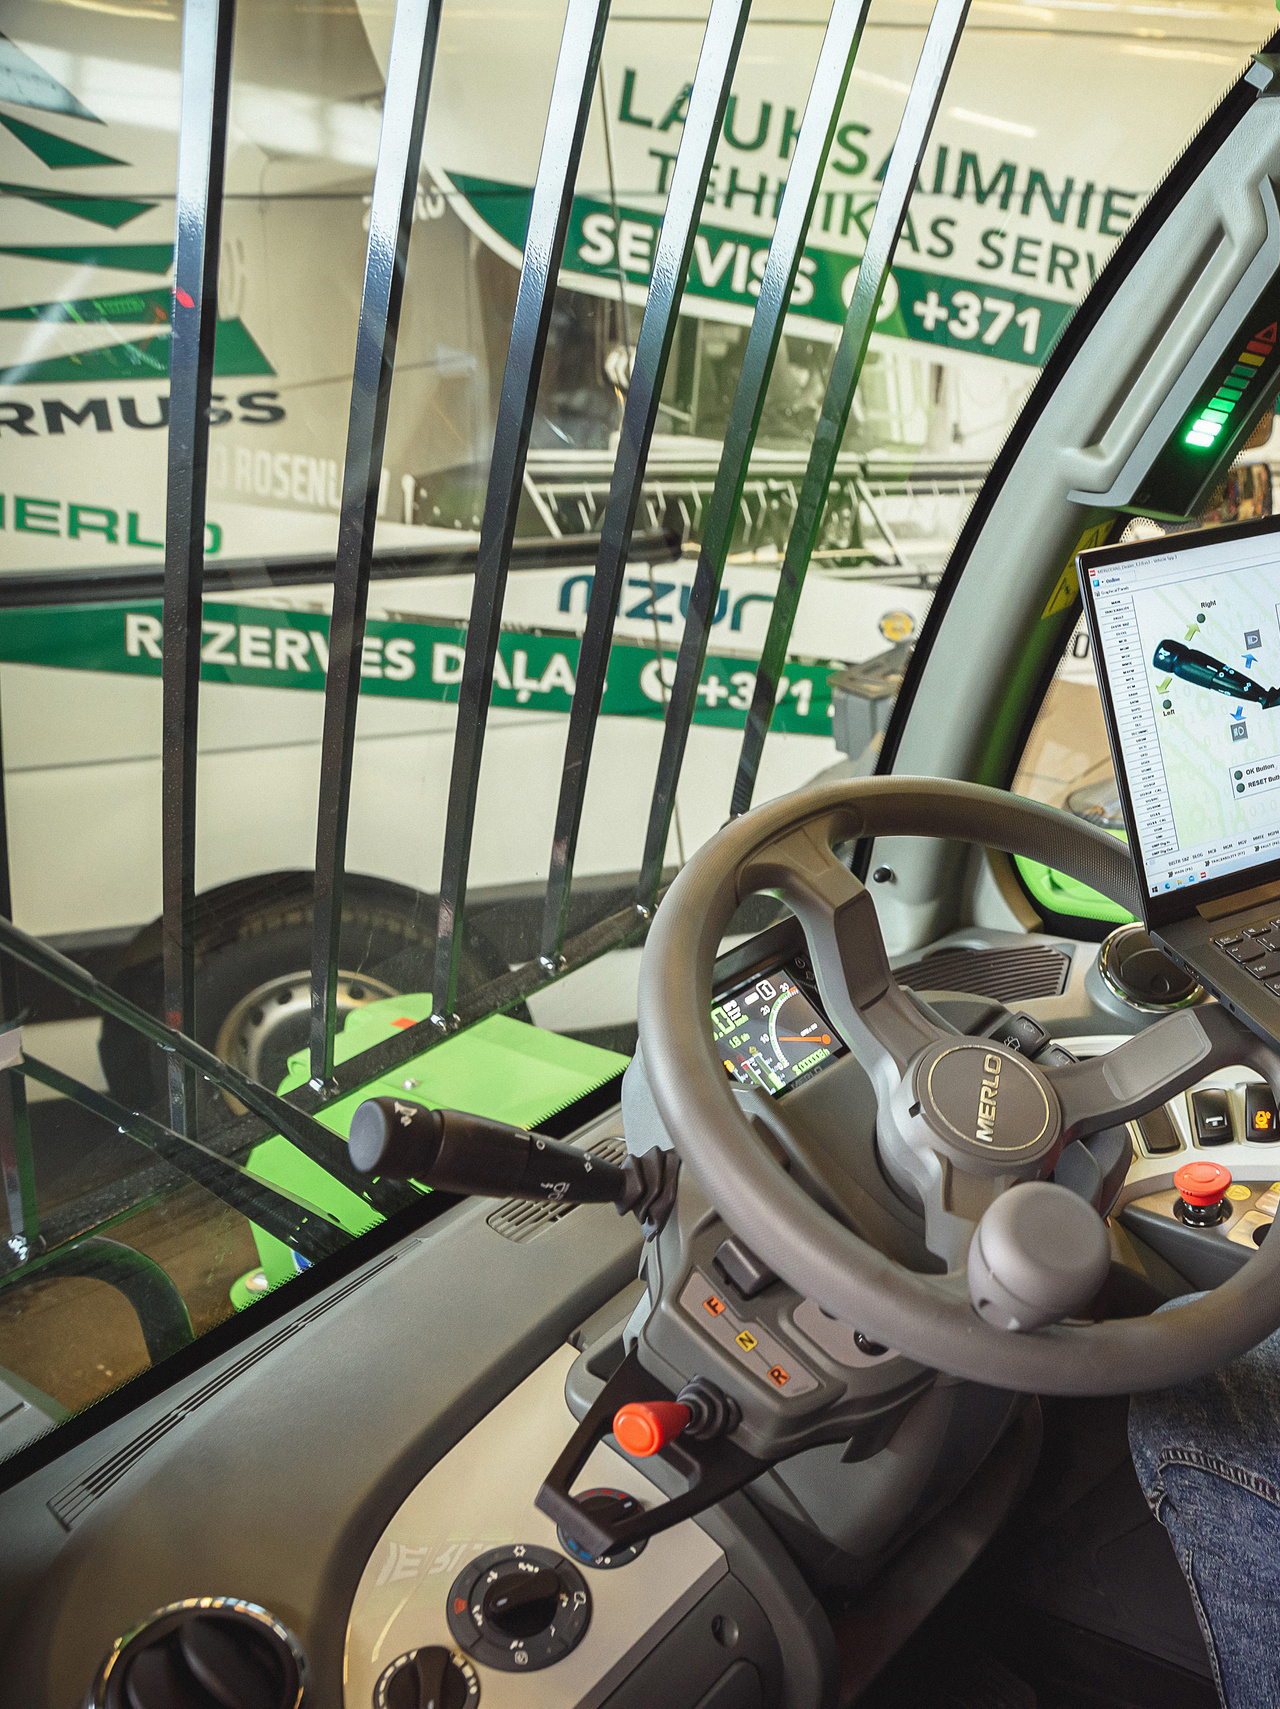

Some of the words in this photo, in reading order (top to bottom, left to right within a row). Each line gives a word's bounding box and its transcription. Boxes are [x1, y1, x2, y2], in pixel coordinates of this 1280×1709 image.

[578, 212, 818, 306] SEVISS
[912, 289, 1042, 355] +371
[0, 493, 222, 554] ERL
[1200, 600, 1216, 608] Right
[125, 612, 416, 682] RZERVES
[432, 641, 608, 704] DĻA
[1163, 709, 1175, 717] Left
[1256, 763, 1274, 773] Button
[1248, 777, 1267, 788] RESET
[760, 1005, 770, 1016] 20
[760, 1034, 770, 1044] 10
[976, 1053, 1002, 1142] MERLO
[706, 1298, 719, 1314] F
[738, 1332, 754, 1349] N
[770, 1369, 788, 1384] R
